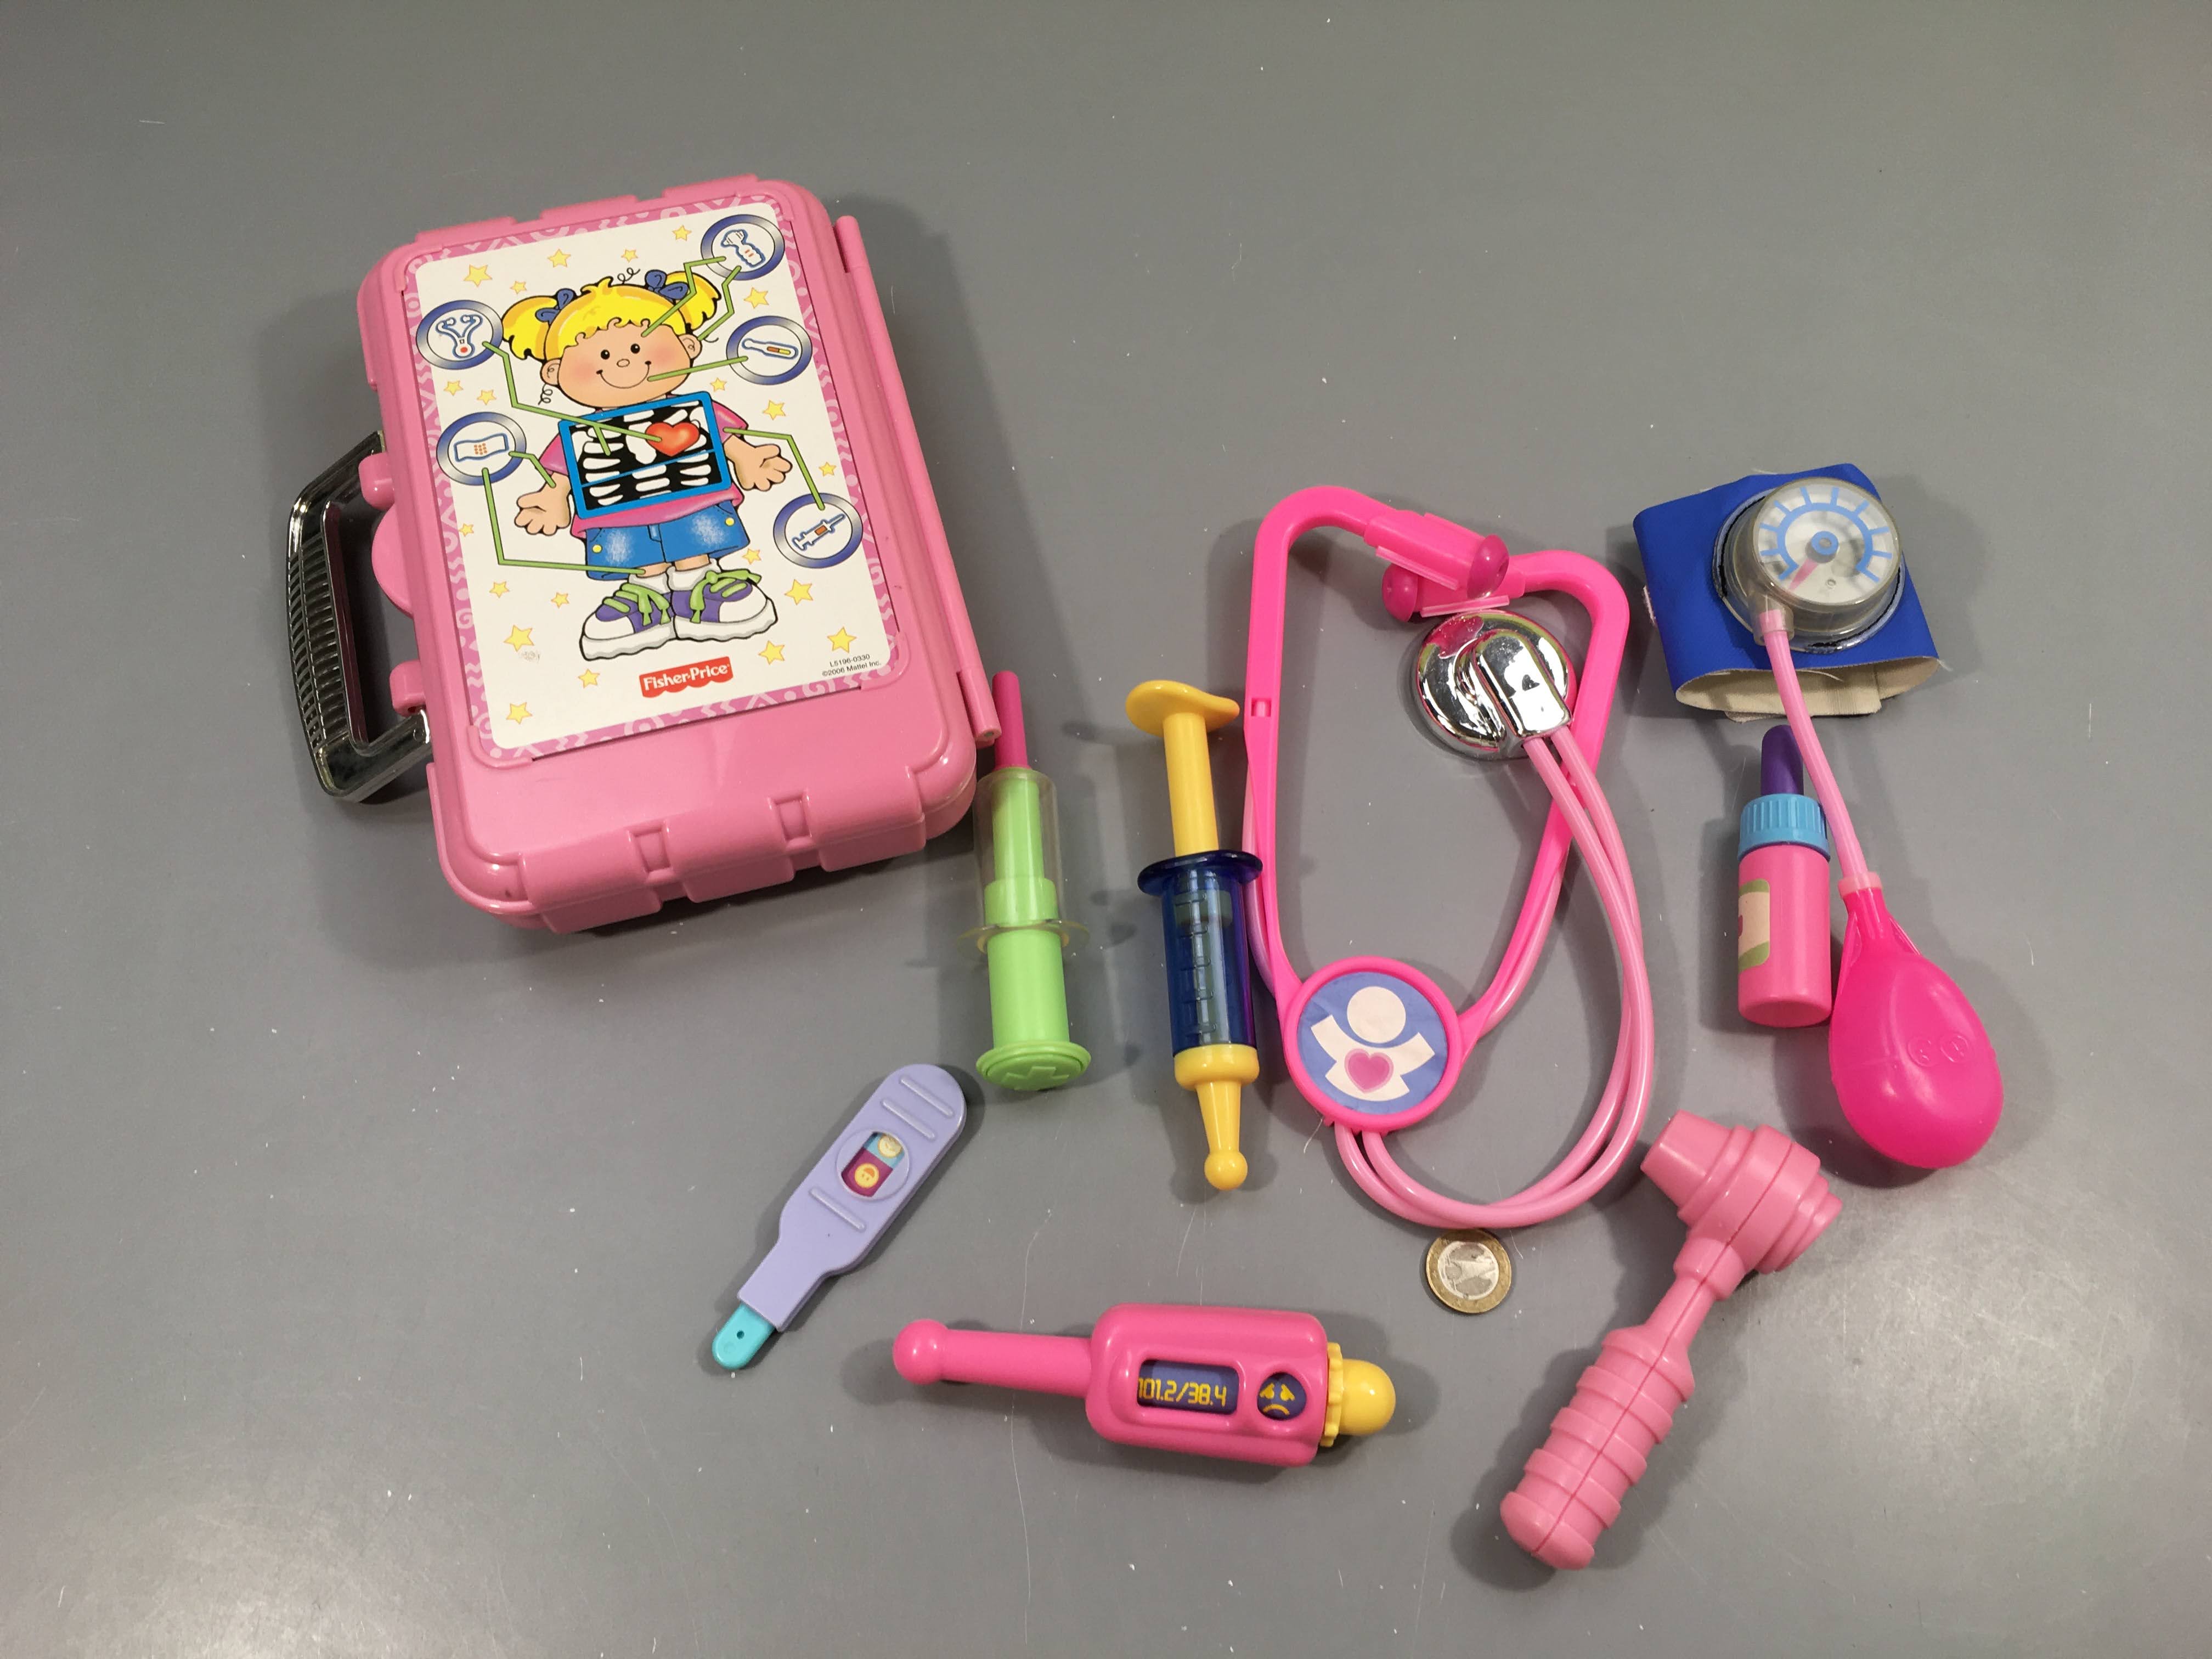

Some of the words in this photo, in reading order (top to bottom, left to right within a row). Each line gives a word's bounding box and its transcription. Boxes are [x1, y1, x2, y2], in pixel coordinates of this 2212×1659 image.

[643, 664, 728, 691] Fisher-Price
[847, 663, 867, 672] Mattel
[1137, 1377, 1227, 1407] 101.2/38.4
